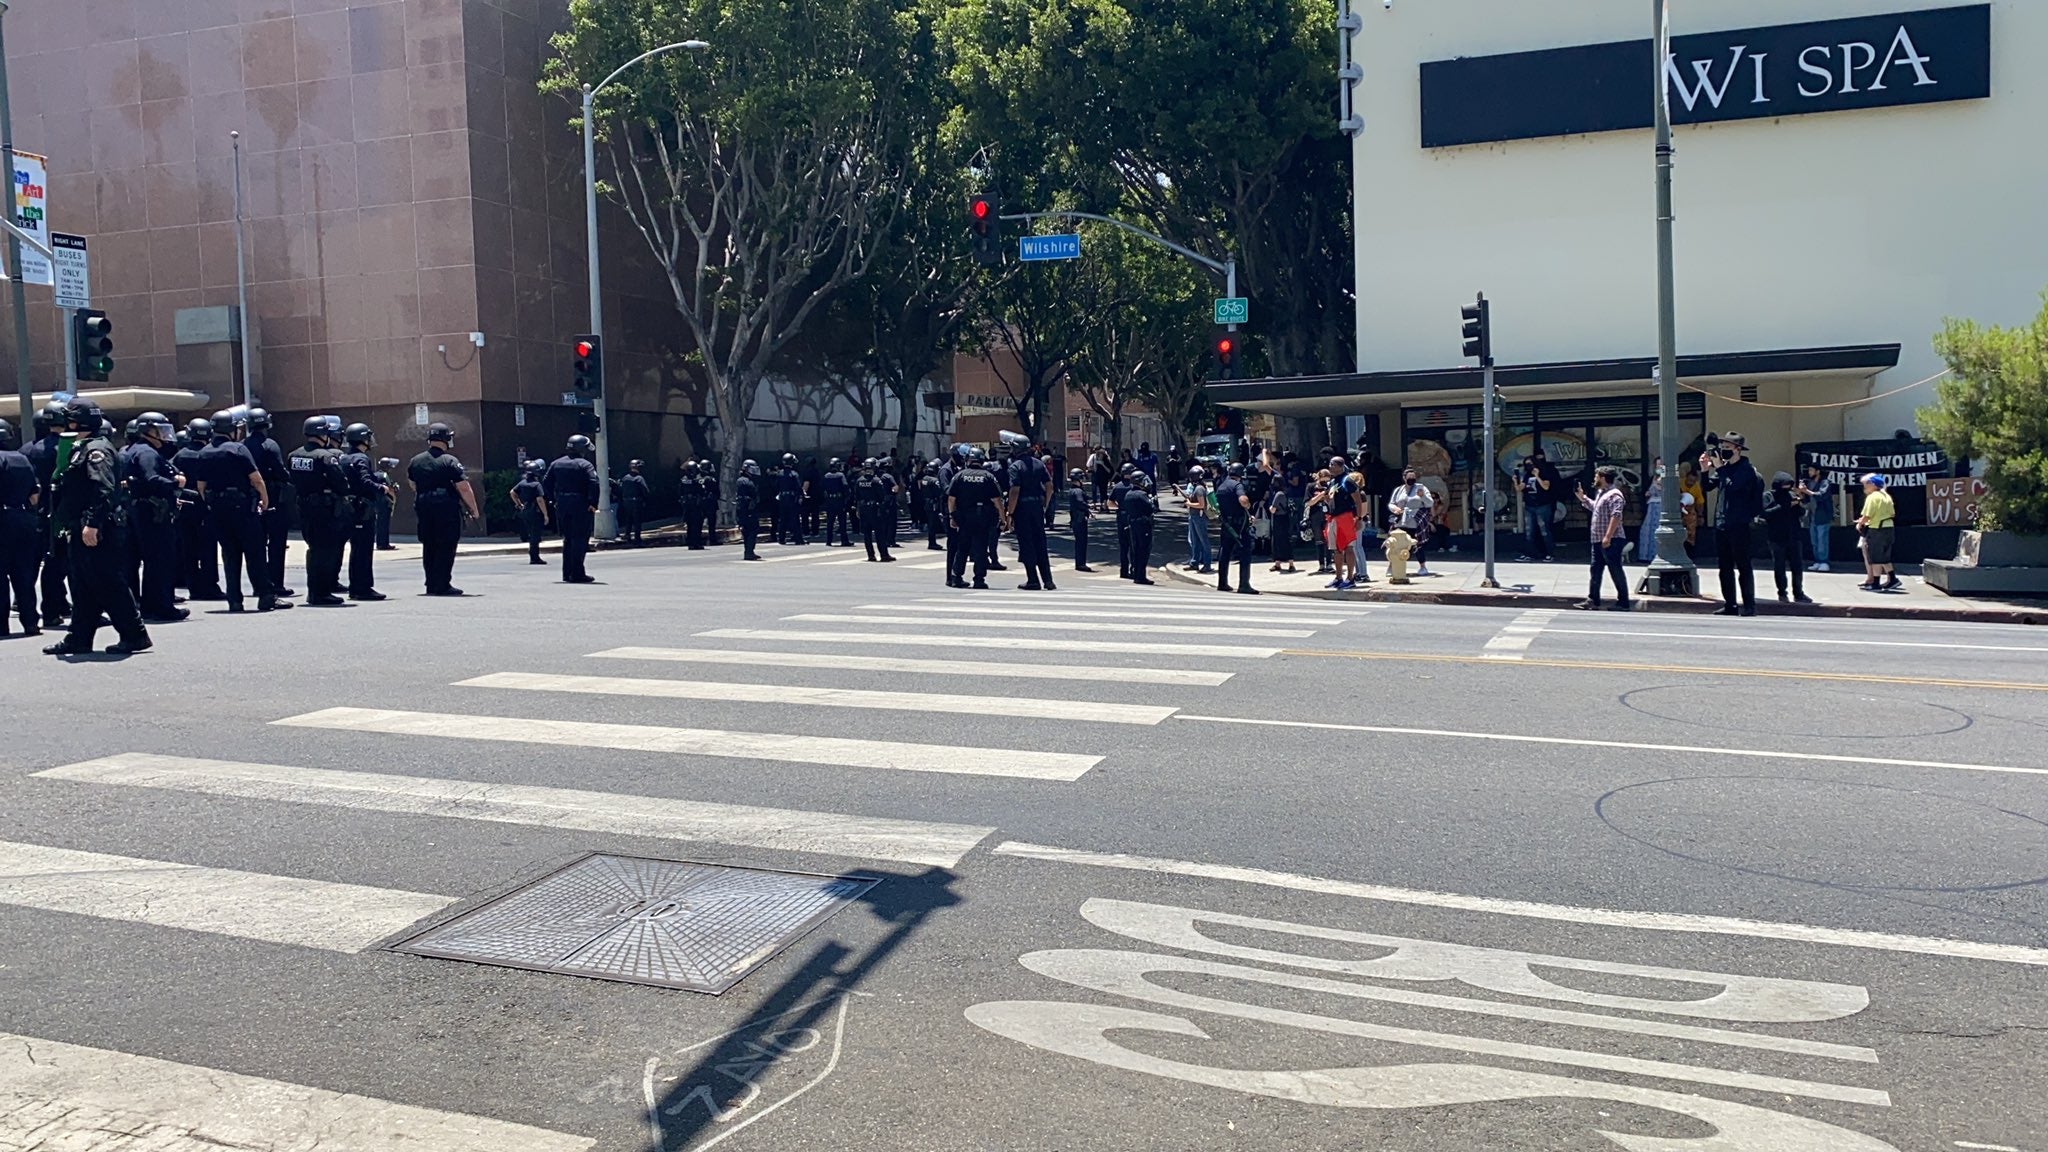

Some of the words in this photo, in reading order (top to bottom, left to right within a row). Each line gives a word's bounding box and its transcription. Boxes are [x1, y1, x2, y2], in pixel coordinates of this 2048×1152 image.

[1667, 45, 1771, 112] WI
[1797, 25, 1938, 97] SPA
[25, 186, 40, 198] Art
[25, 208, 40, 220] the
[54, 237, 69, 245] RIGHT
[1024, 241, 1076, 255] Wilshire
[58, 249, 82, 260] BUSES
[62, 268, 80, 278] ONLY
[968, 394, 1015, 408] PARKIN
[1553, 441, 1586, 460] WI
[1596, 440, 1636, 459] SPA
[1811, 452, 1859, 468] TRANS
[1877, 451, 1938, 469] WOMEN
[963, 475, 985, 483] POLICE
[1827, 470, 1856, 485] ARE
[1883, 472, 1927, 487] OMEN
[1932, 481, 1965, 496] WE
